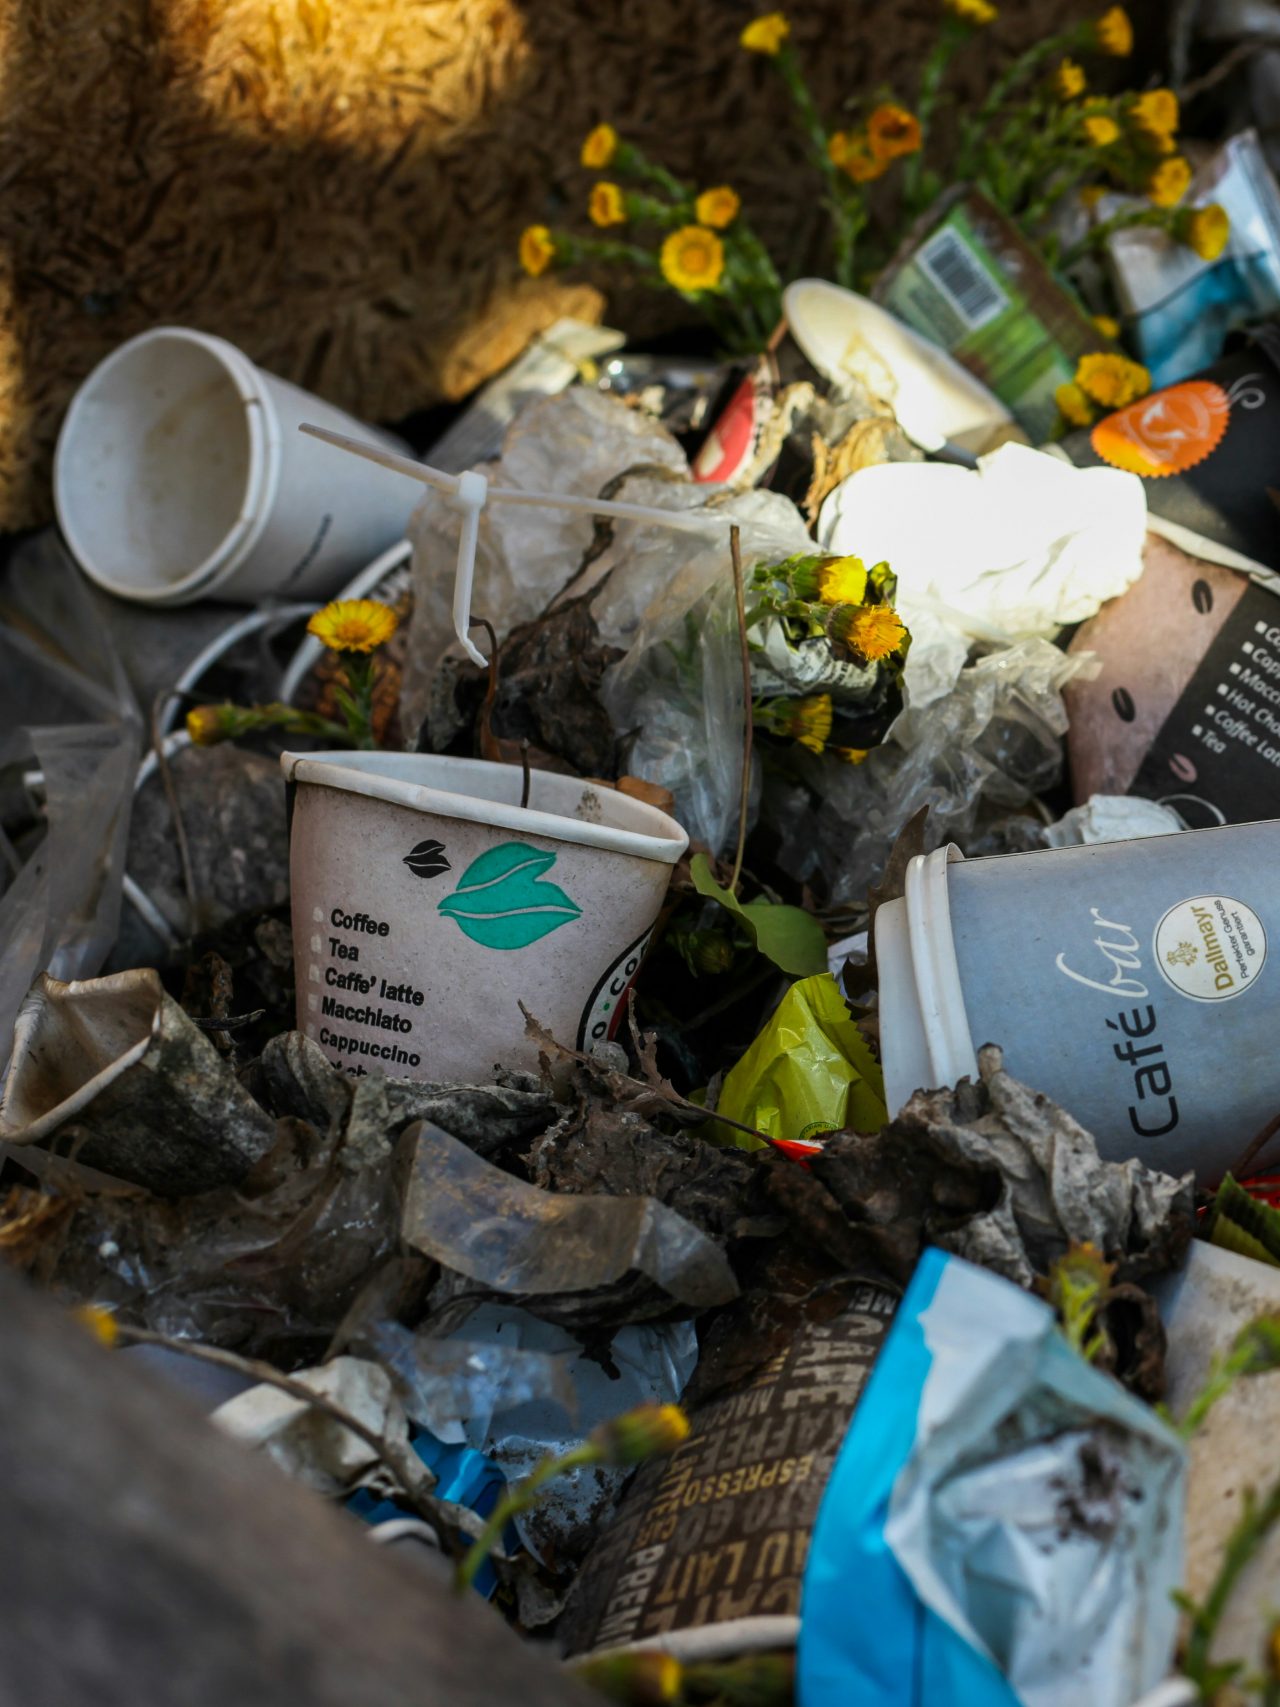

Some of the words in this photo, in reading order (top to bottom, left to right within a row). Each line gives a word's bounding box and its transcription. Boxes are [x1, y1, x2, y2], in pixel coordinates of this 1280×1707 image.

[1226, 688, 1256, 714] Hot
[1201, 729, 1227, 755] Tea
[1214, 710, 1259, 747] Coffee
[330, 908, 390, 937] Coffee
[1213, 899, 1233, 934] Genuss
[1230, 910, 1257, 957] garantiert
[328, 937, 360, 962] Tea
[1056, 907, 1150, 998] bar
[1189, 904, 1235, 992] Dallmayr
[1227, 933, 1250, 980] Perfekter
[379, 978, 425, 1007] latte
[321, 996, 413, 1034] Macchiato
[320, 1027, 421, 1067] Cappuccino
[1106, 1004, 1179, 1138] Café
[681, 1454, 815, 1505] ESPRESSO
